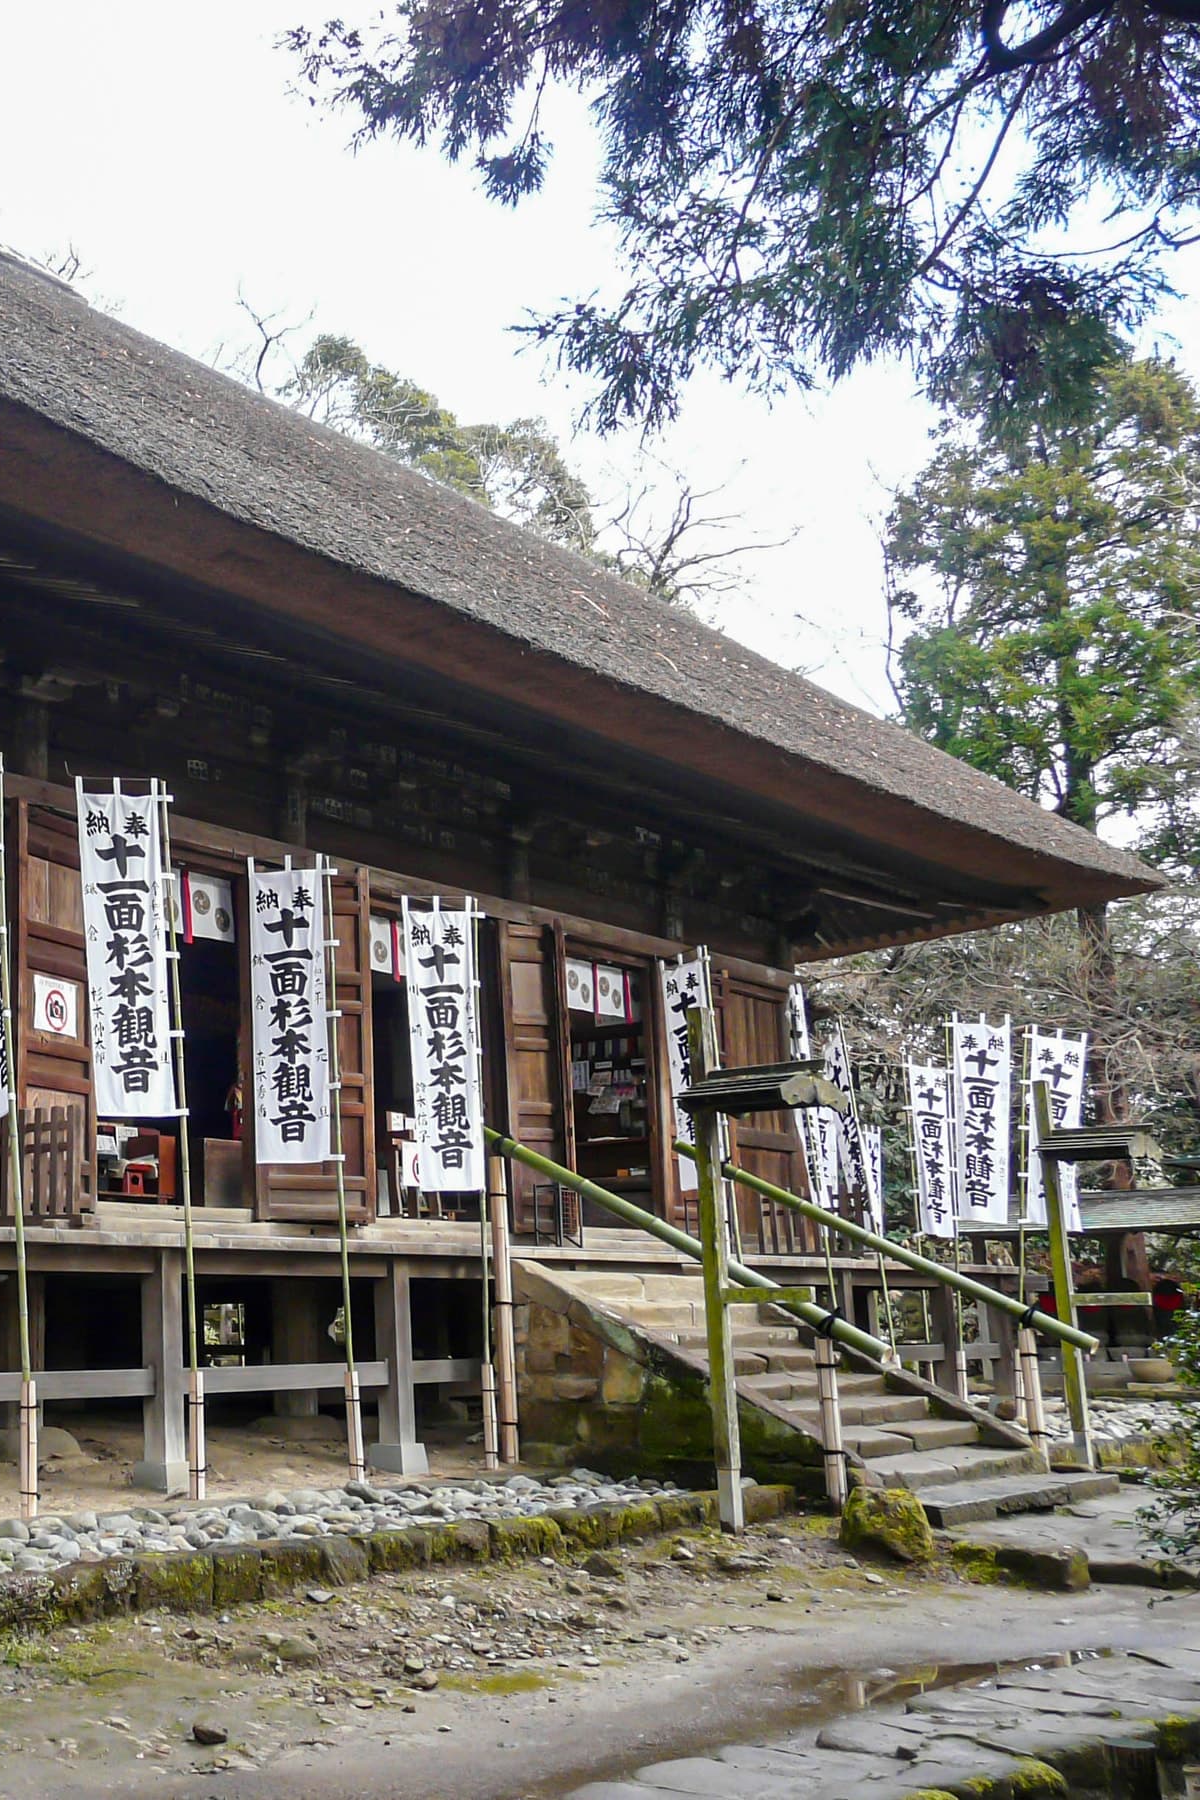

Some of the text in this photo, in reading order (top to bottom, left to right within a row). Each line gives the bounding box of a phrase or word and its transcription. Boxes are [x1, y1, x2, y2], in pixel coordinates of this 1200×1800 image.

[85, 809, 150, 839] 奉納
[94, 832, 159, 1094] 十一面杉本観音
[255, 885, 316, 914] 奉納
[410, 923, 466, 949] 奉納
[262, 908, 317, 1144] 十一面杉本観音
[417, 943, 474, 1170] 十一面杉本観音
